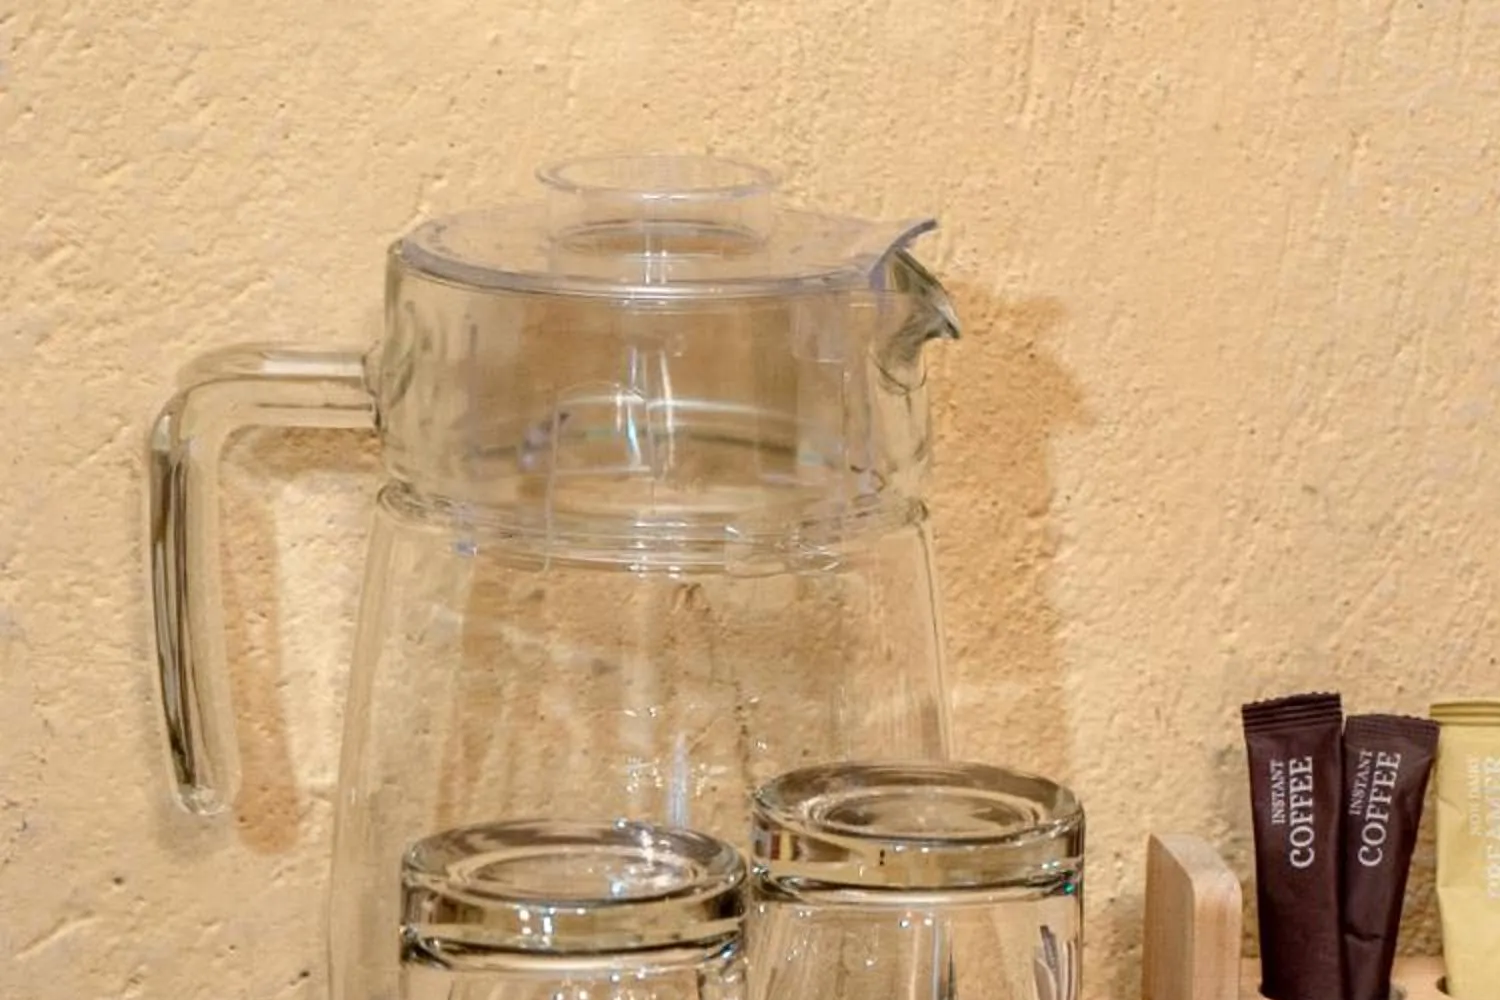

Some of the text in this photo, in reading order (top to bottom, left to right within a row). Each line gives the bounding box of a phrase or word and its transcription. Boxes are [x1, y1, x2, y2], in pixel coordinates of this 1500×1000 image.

[1270, 760, 1285, 825] INSTANT
[1289, 756, 1315, 869] COFFEE
[1350, 750, 1374, 816] INSTANT
[1357, 752, 1401, 867] COFFEE
